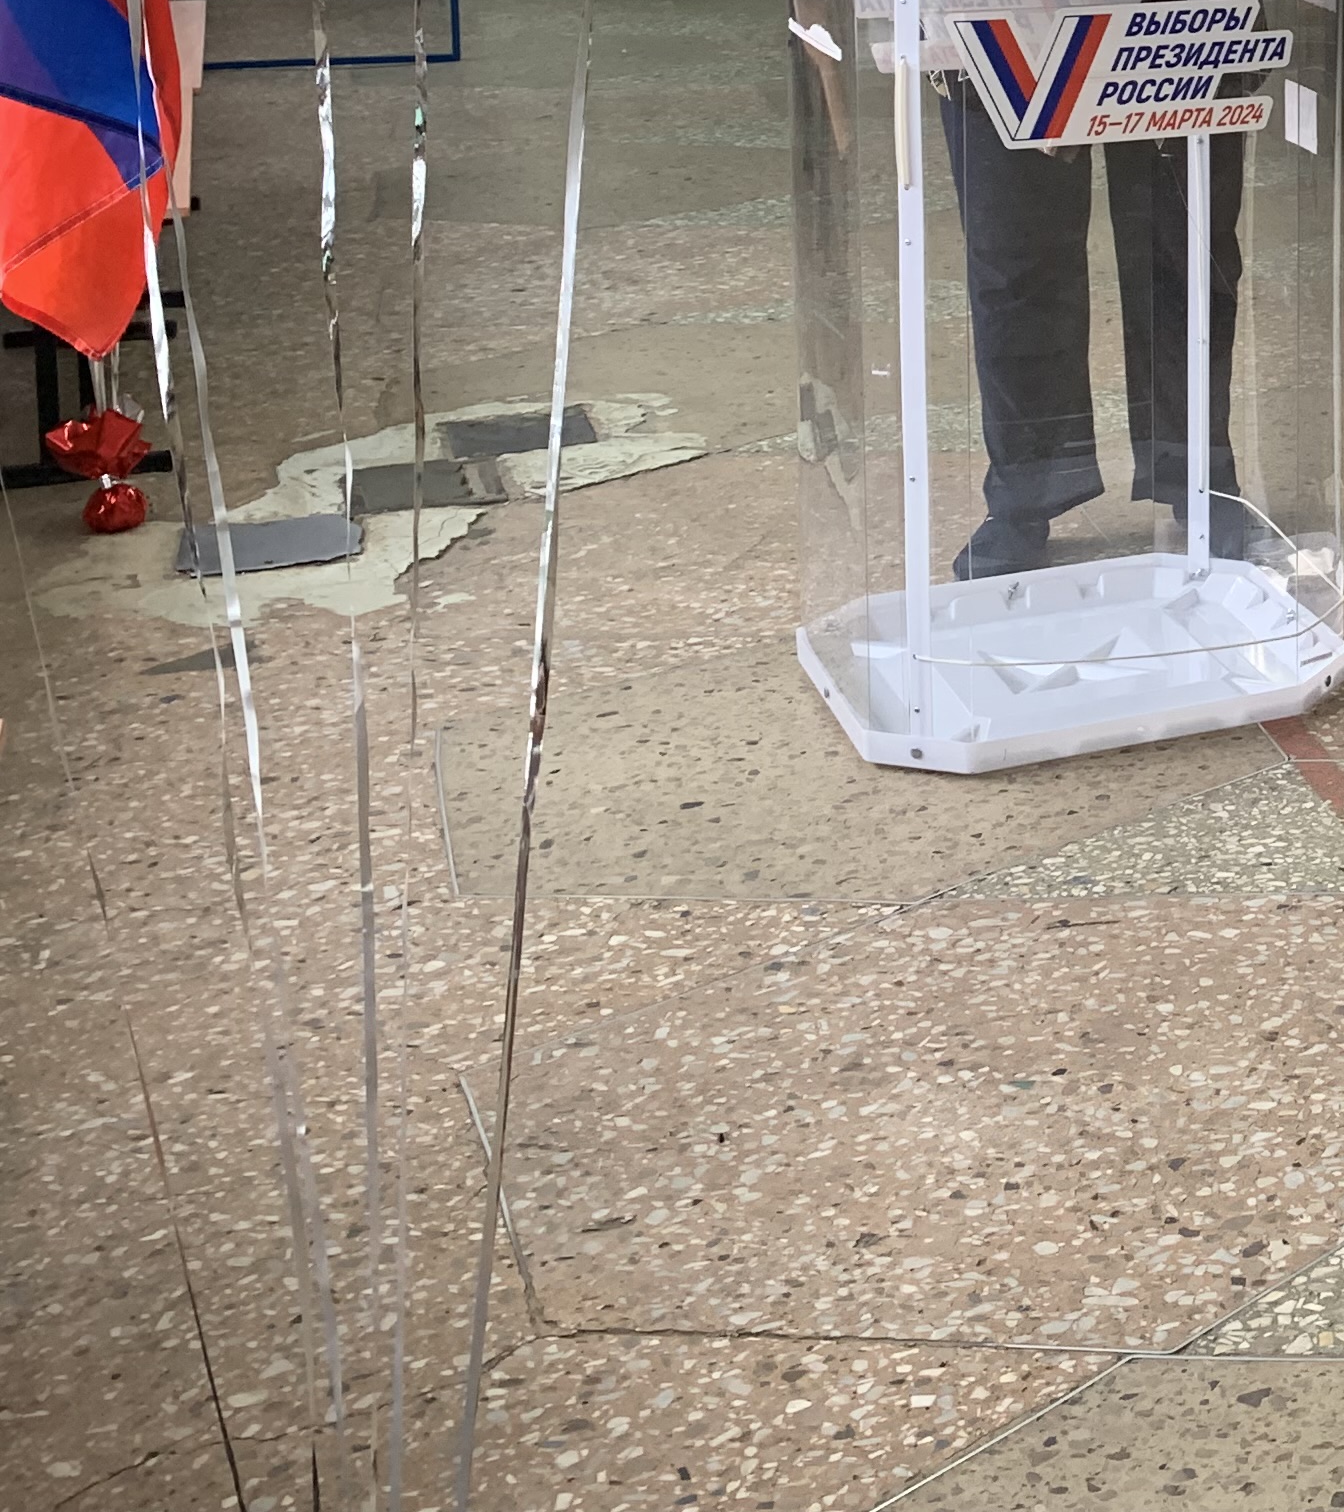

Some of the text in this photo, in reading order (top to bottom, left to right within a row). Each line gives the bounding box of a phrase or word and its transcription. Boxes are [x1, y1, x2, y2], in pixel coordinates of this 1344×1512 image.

[1125, 6, 1252, 37] ВЫБОРЫ
[1111, 37, 1287, 71] ПРЕЗИДЕНТА
[1097, 75, 1214, 106] РОССИИ
[1145, 107, 1213, 132] МАРТА
[1216, 103, 1264, 126] 2024
